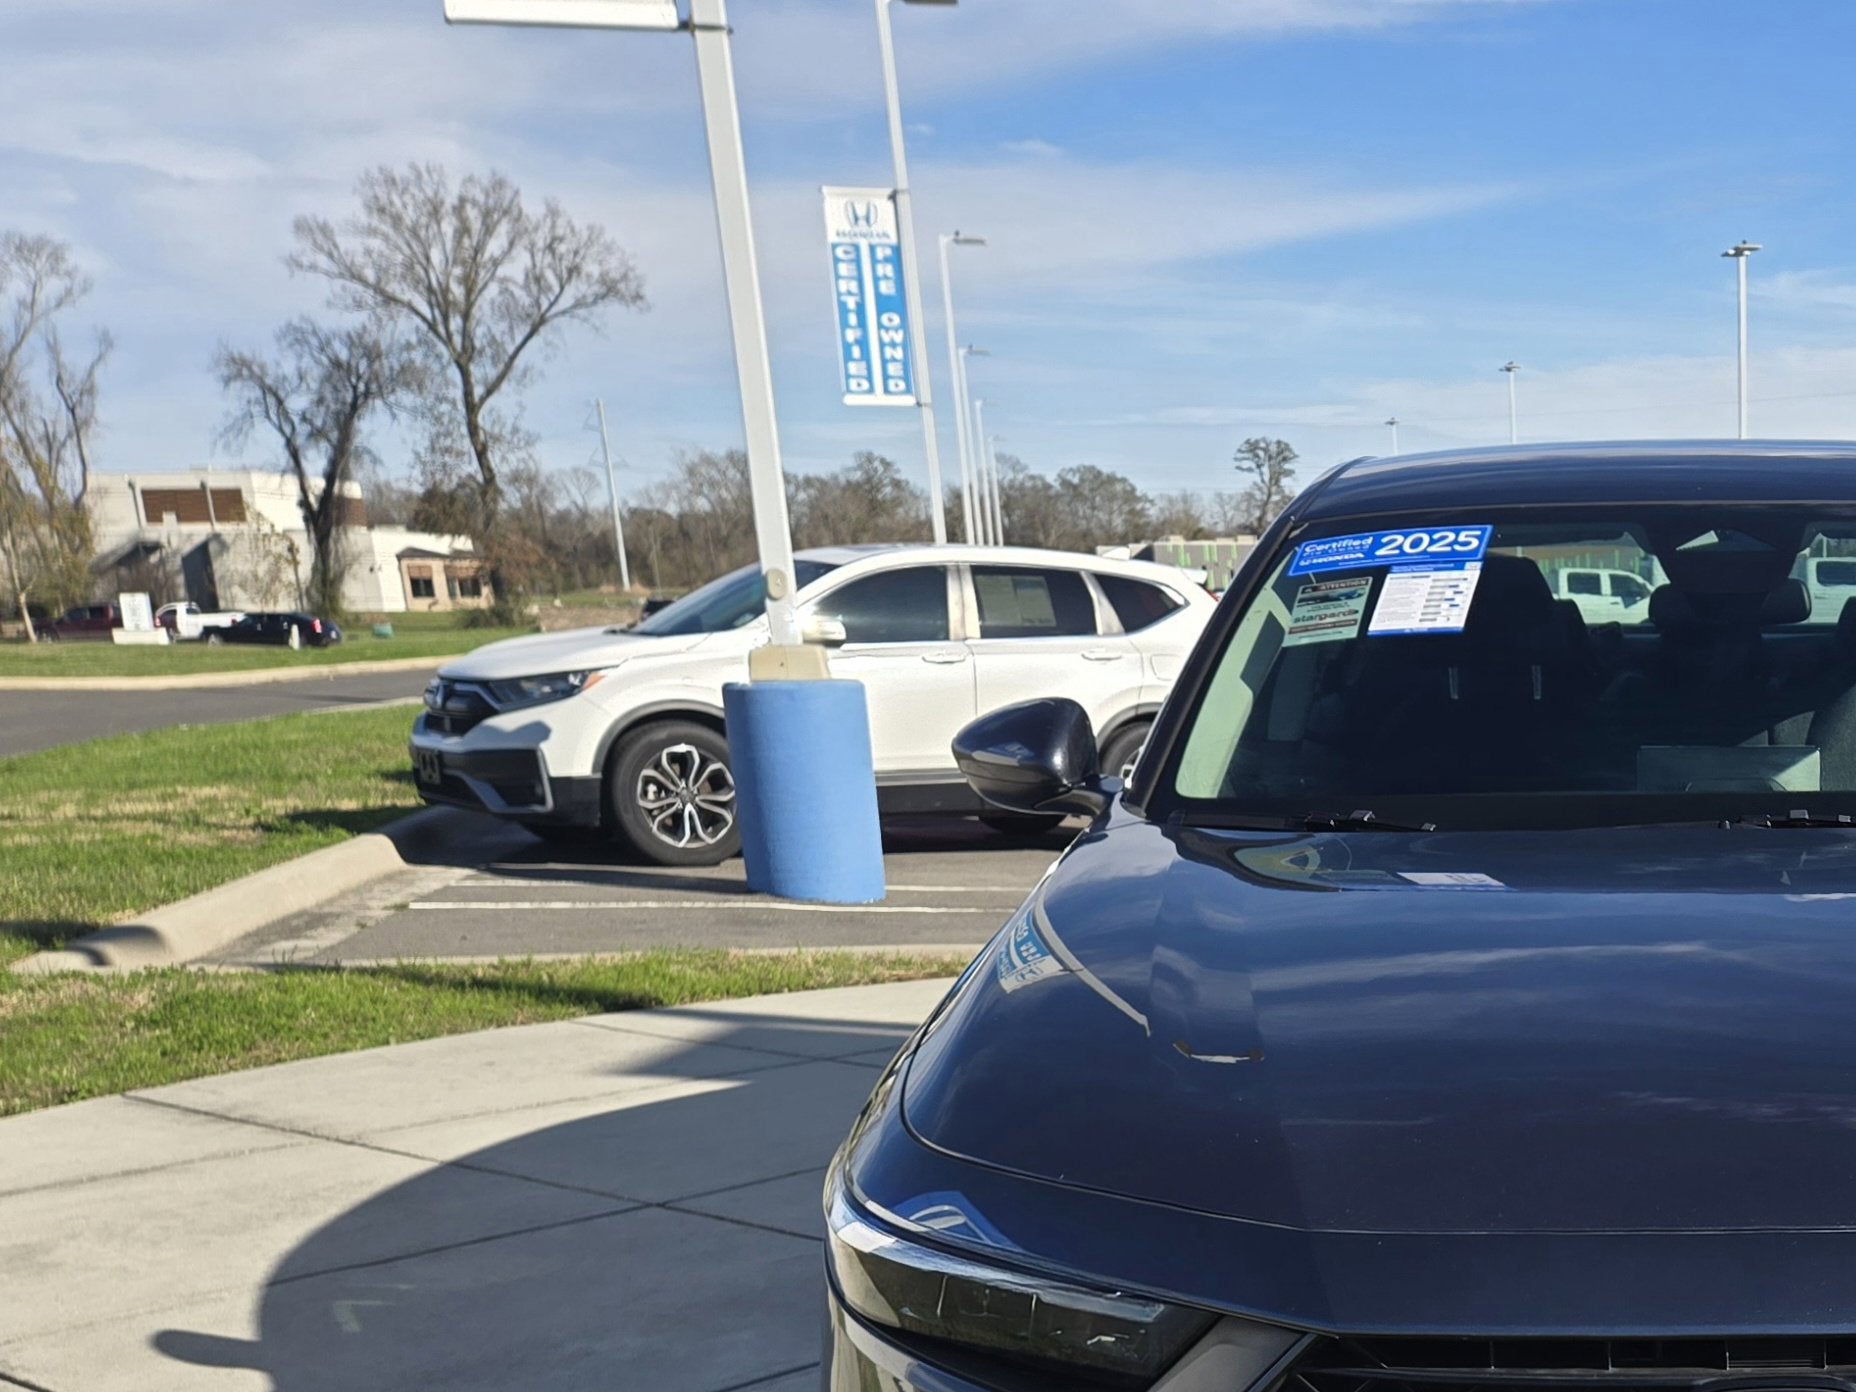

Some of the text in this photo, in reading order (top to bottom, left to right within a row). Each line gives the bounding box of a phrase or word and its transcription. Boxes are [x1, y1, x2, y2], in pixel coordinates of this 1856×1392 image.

[834, 244, 871, 392] CERTIFIED
[874, 245, 907, 393] PRE OWNED
[1304, 536, 1374, 554] Certified
[1375, 530, 1482, 556] 2025
